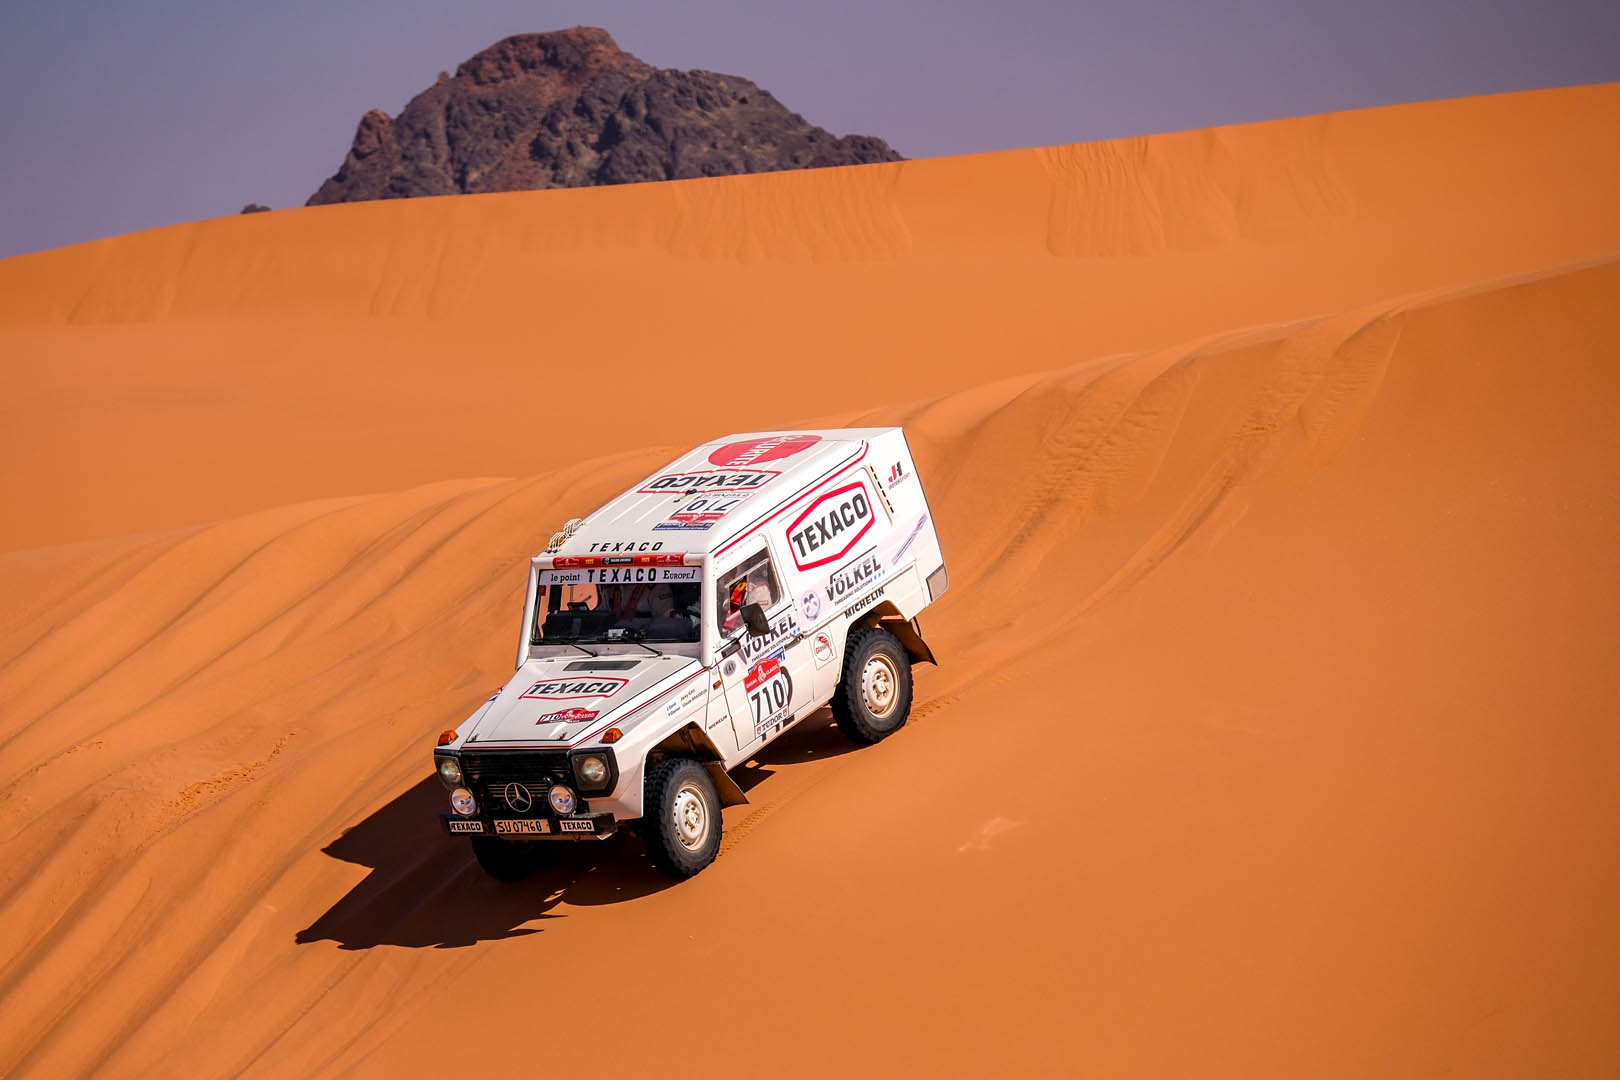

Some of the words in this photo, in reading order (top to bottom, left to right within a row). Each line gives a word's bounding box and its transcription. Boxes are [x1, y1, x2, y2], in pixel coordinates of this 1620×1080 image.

[649, 474, 769, 490] TEXACO
[687, 499, 740, 512] 710
[792, 493, 869, 558] TEXACO
[589, 541, 664, 553] TEXACO
[551, 573, 559, 582] le
[560, 573, 581, 583] point
[588, 568, 657, 583] TEXACO
[825, 555, 882, 602] VÖLKEL
[844, 586, 885, 620] MICHELIN
[528, 681, 620, 696] TEXACO
[751, 679, 785, 724] 710
[761, 714, 783, 731] TUDOR
[452, 822, 481, 832] TEXACO
[562, 821, 593, 831] TEXACO
